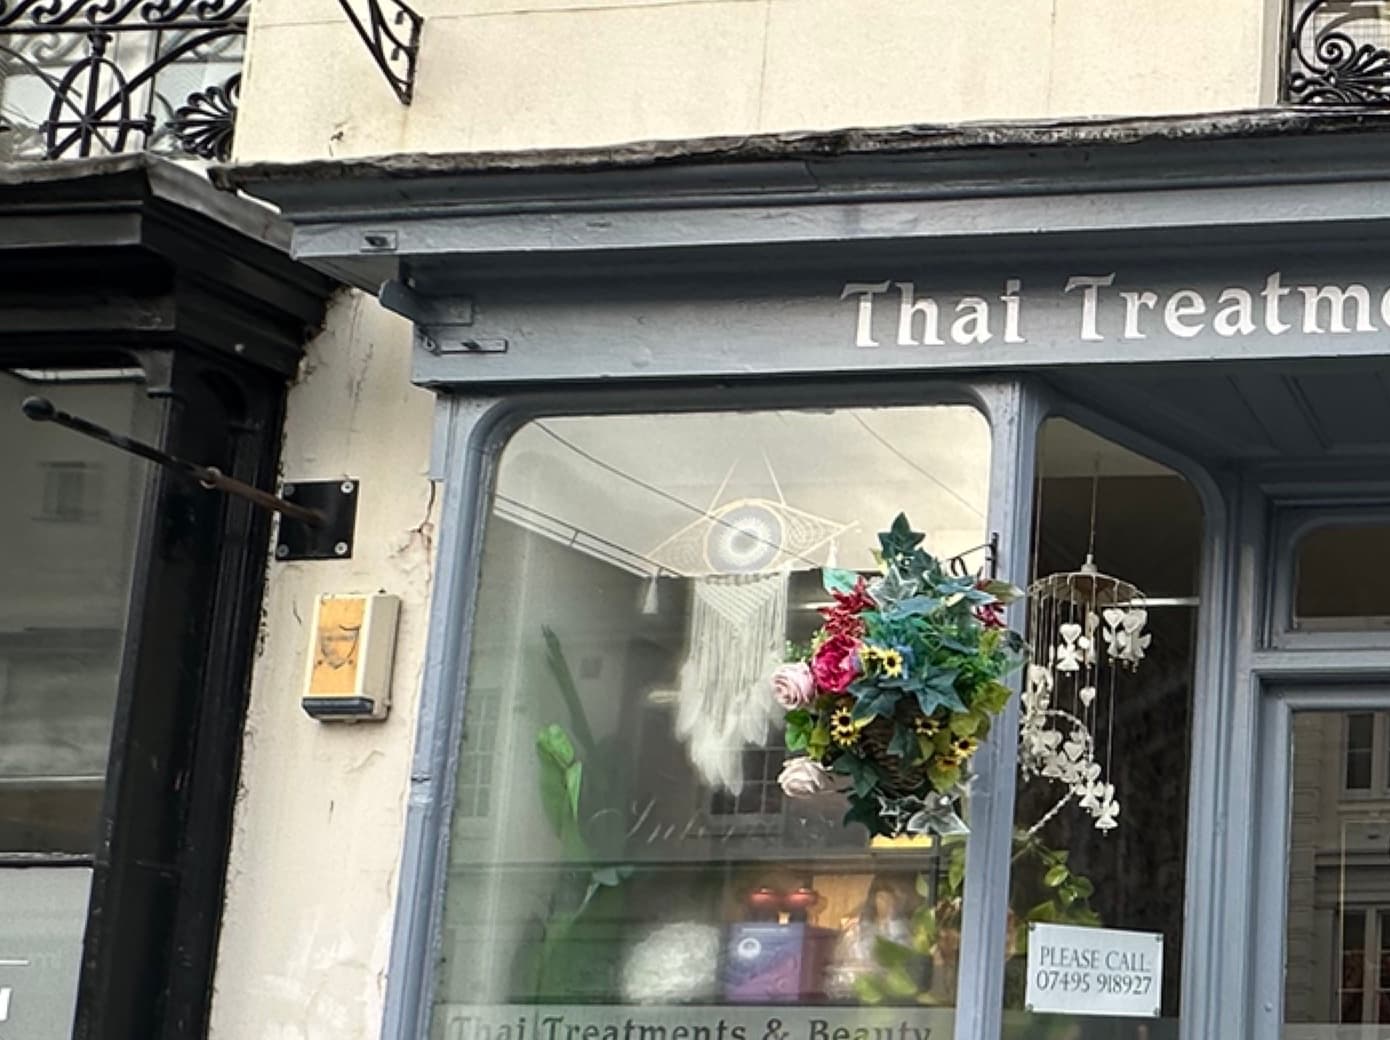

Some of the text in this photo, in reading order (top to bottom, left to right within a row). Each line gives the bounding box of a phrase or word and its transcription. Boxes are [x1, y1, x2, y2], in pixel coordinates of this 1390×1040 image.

[840, 279, 1027, 347] Thai
[1040, 945, 1152, 973] PLEASE CALL
[1036, 969, 1153, 995] 07495 918927
